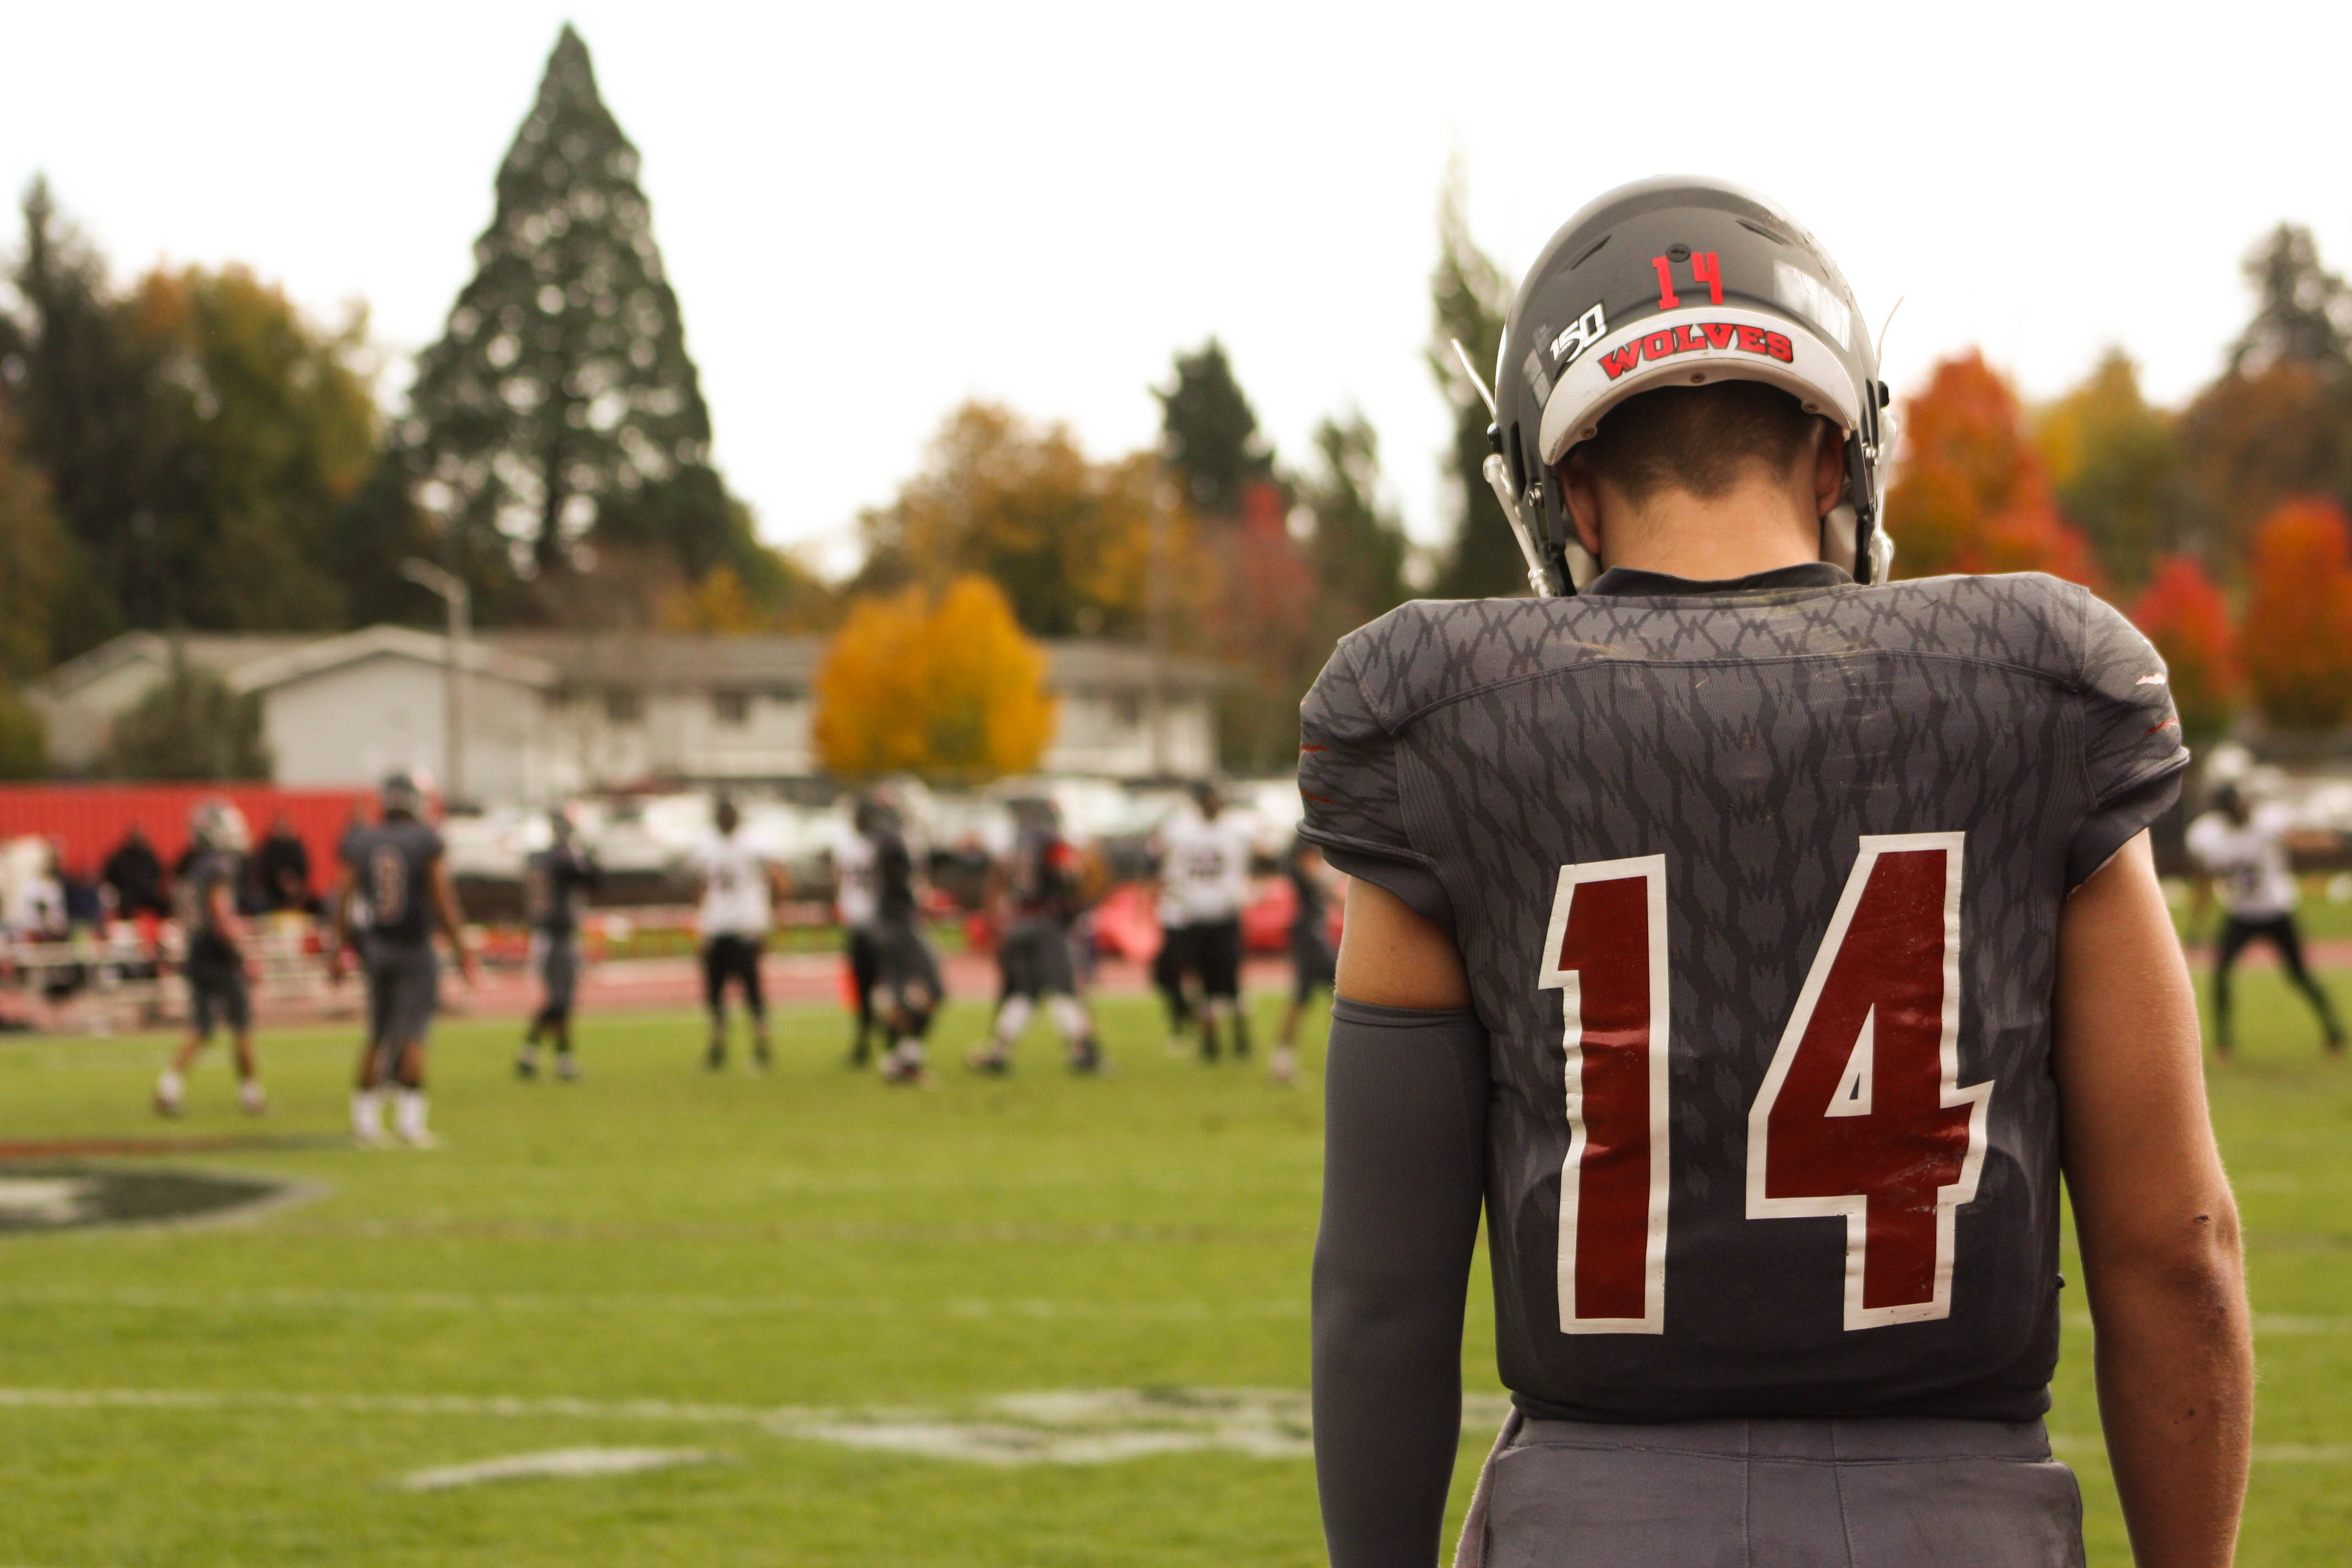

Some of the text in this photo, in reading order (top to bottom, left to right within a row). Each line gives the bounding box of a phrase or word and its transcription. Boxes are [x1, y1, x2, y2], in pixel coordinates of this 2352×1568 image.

[1652, 253, 1723, 310] 14
[1550, 303, 1607, 362] 150
[1597, 323, 1793, 380] WOLVES
[1538, 831, 1995, 1335] 14
